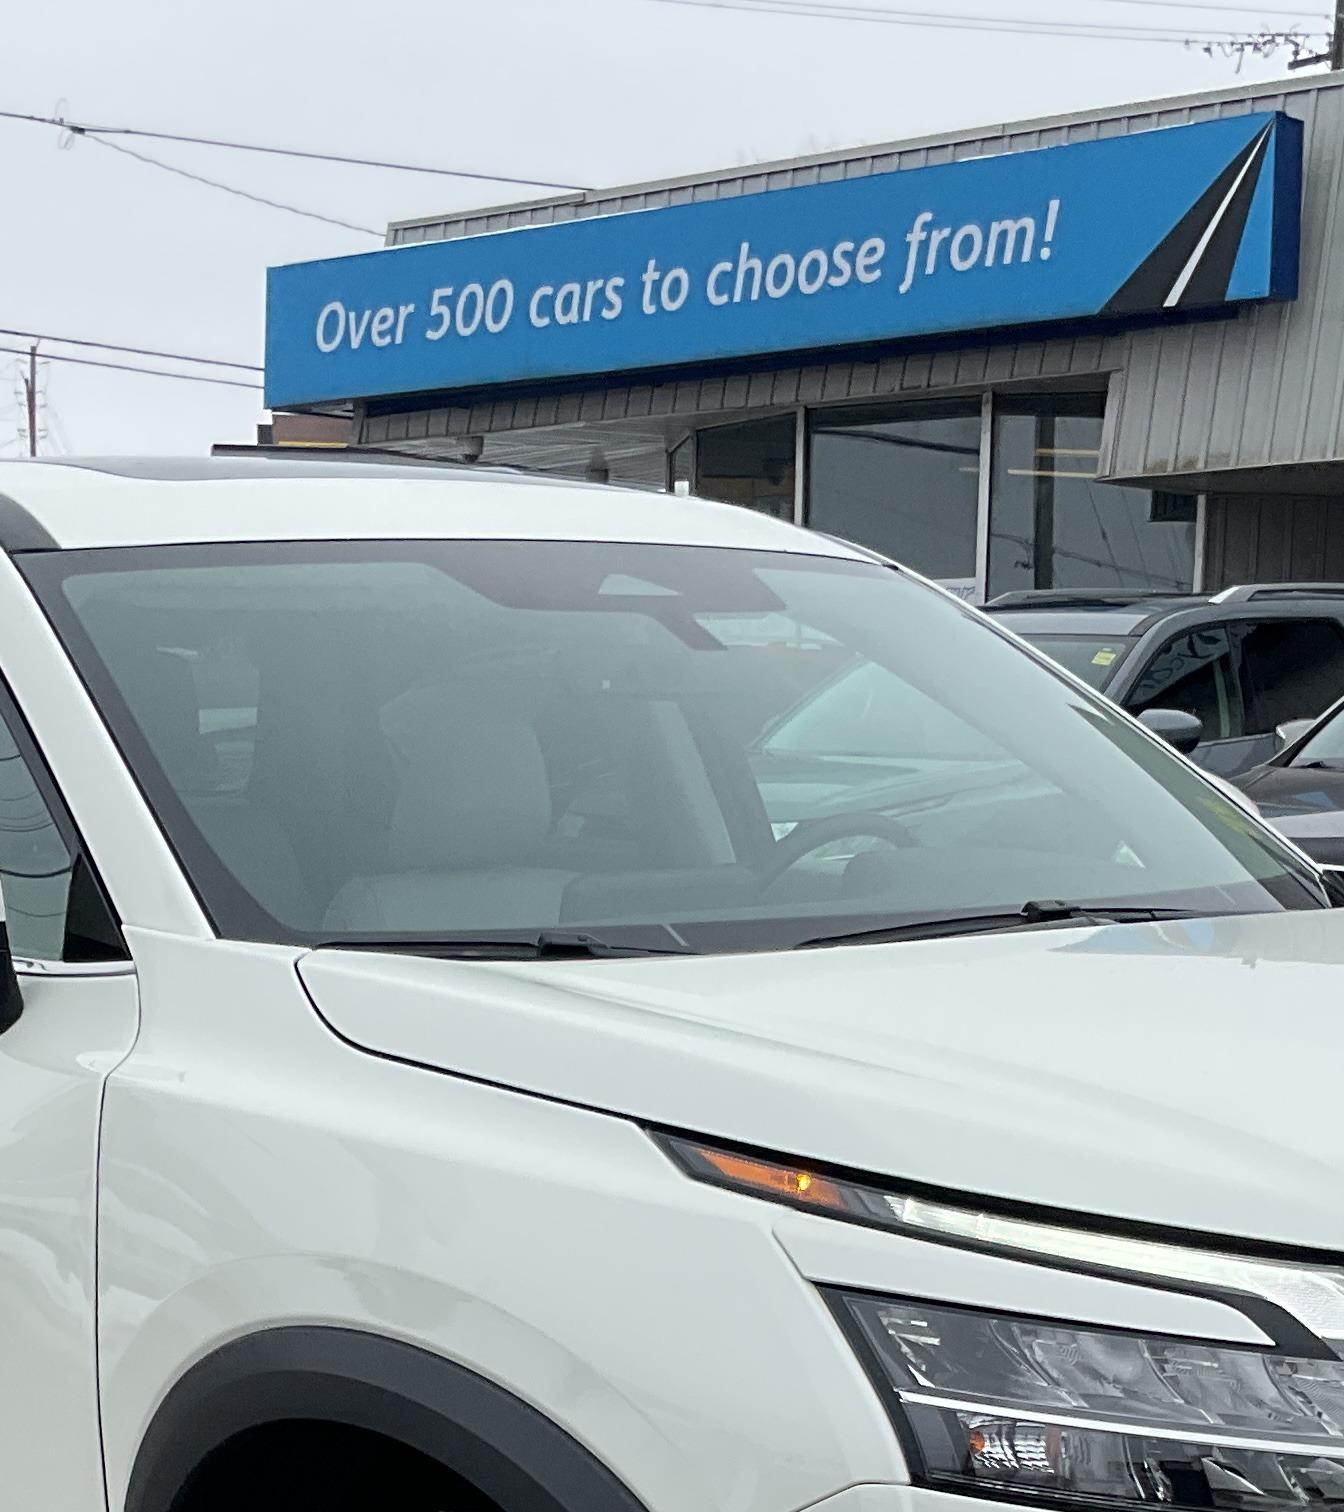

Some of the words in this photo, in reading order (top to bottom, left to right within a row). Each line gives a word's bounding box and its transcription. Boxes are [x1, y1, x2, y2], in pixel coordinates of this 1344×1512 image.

[316, 301, 414, 353] Over
[425, 279, 514, 341] 500
[529, 276, 625, 328] cars
[642, 259, 689, 314] to
[706, 242, 886, 306] choose
[898, 199, 1060, 294] from!
